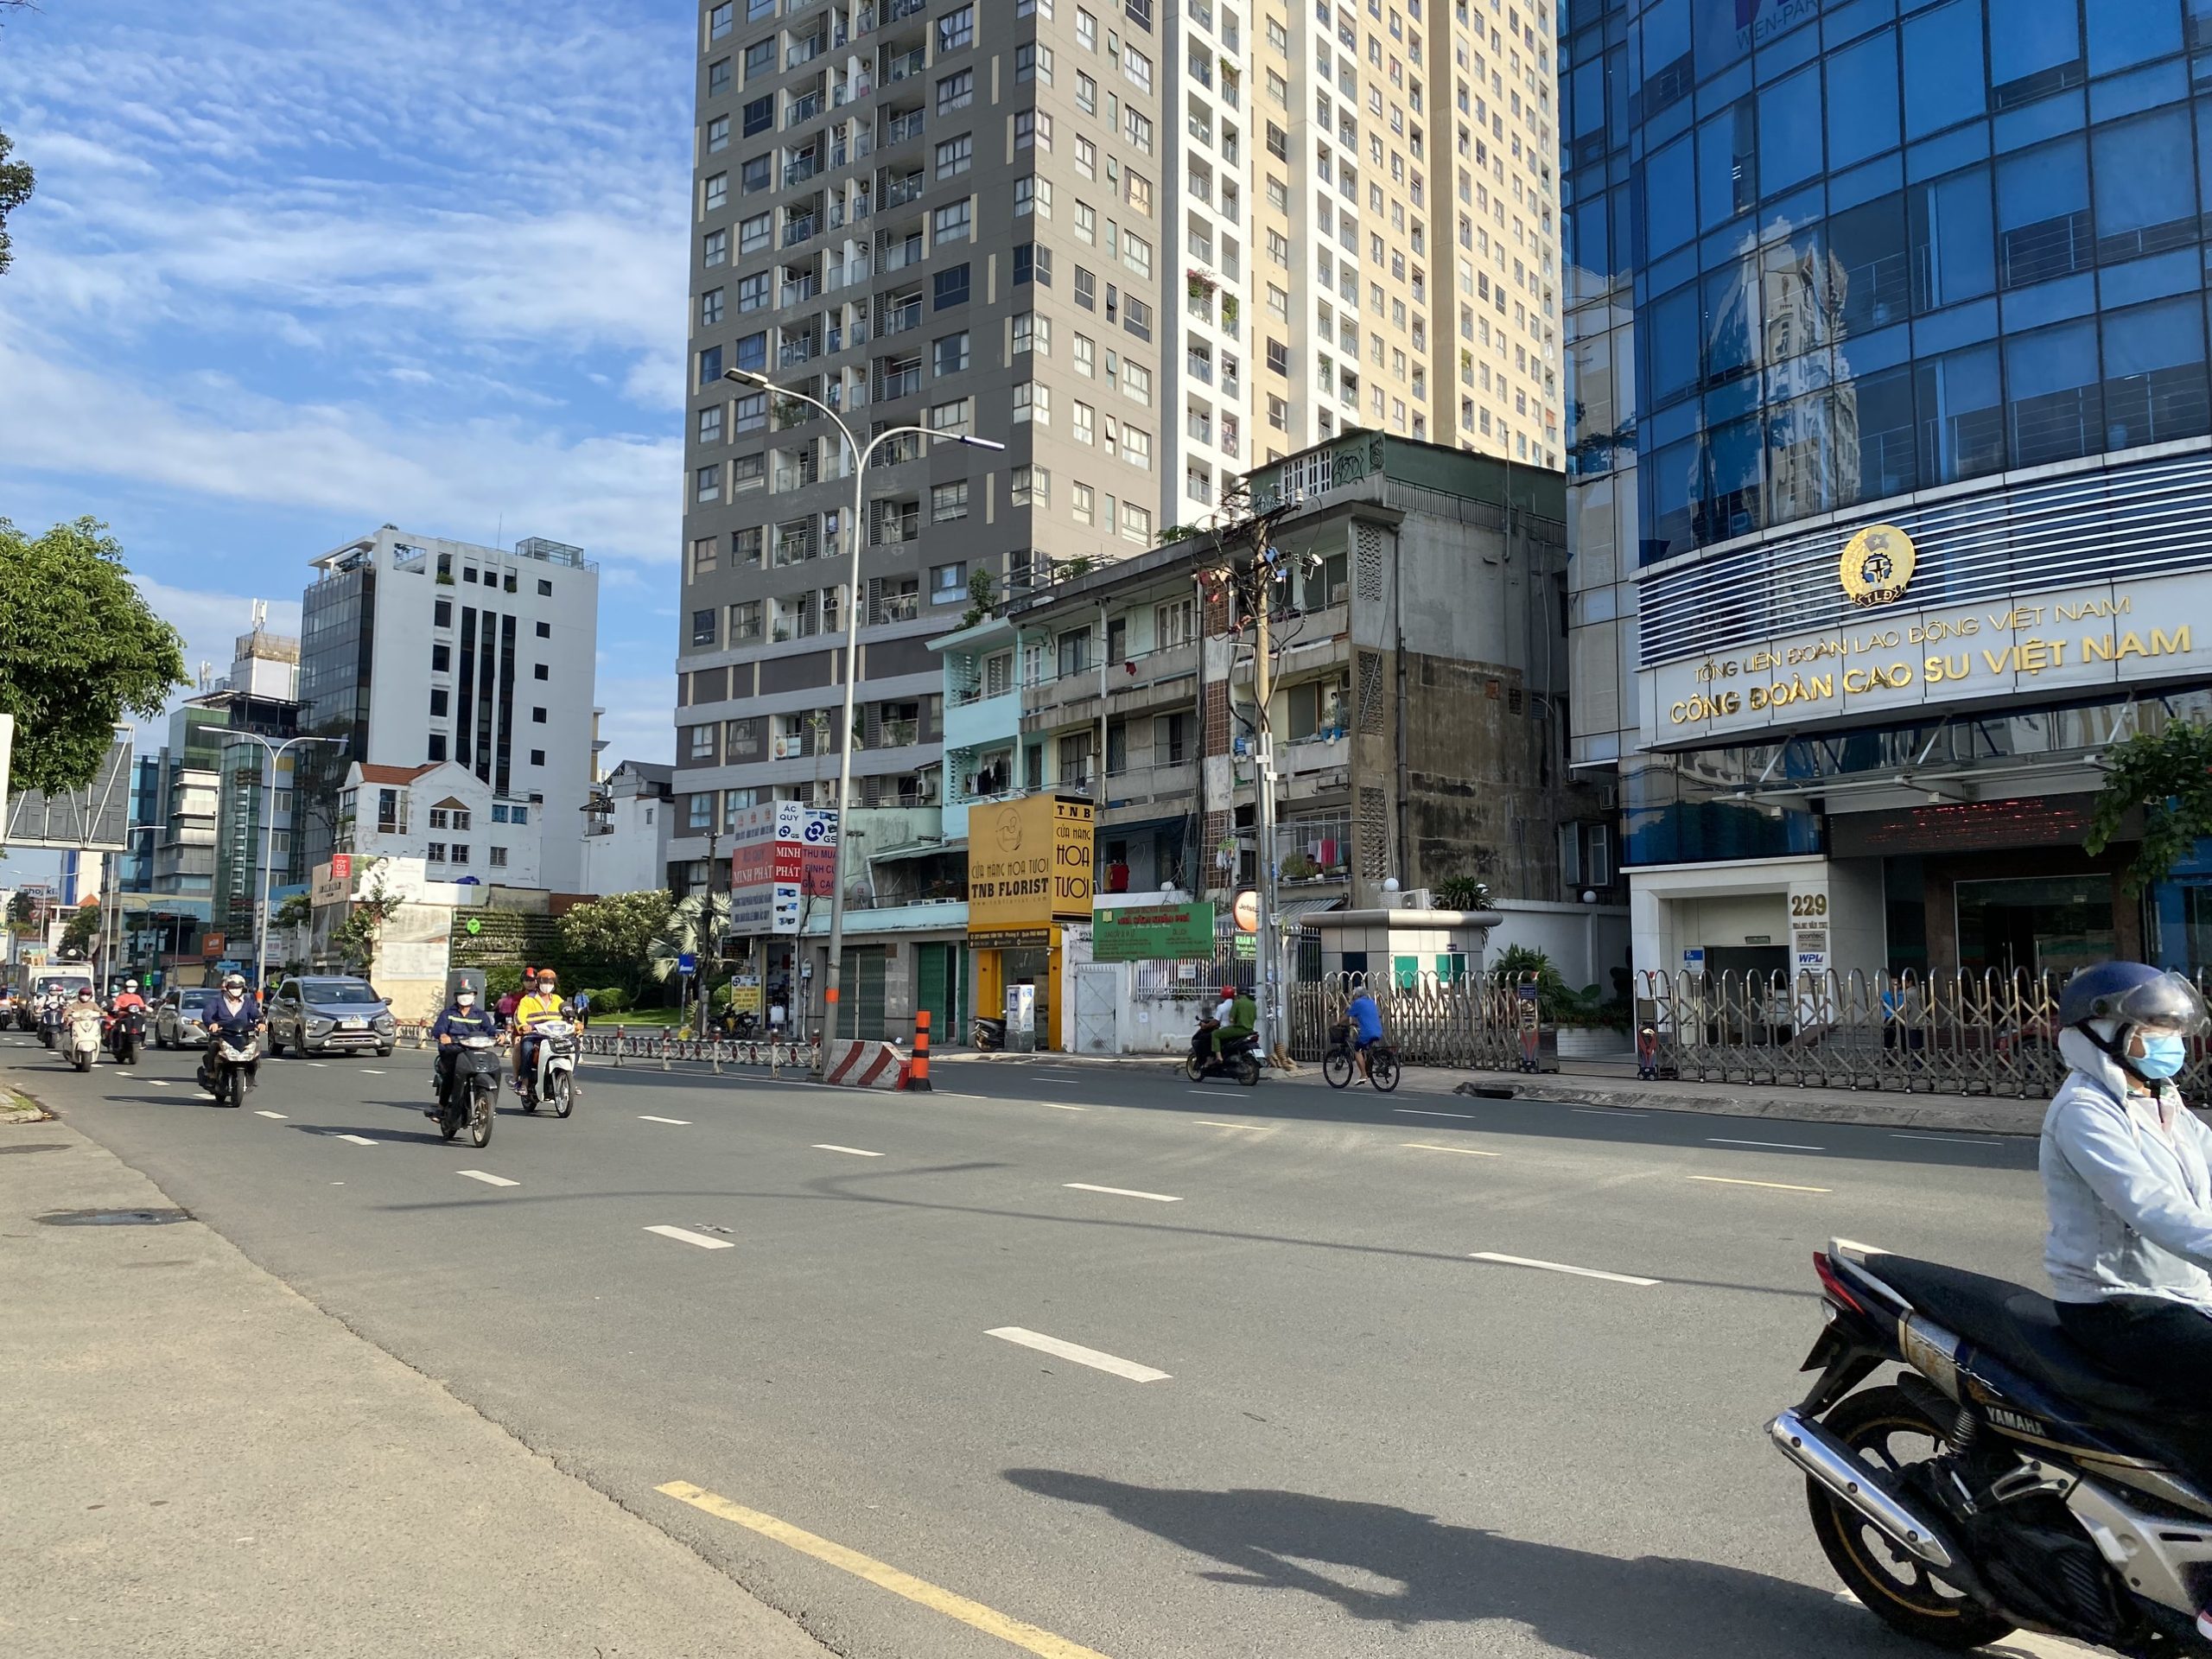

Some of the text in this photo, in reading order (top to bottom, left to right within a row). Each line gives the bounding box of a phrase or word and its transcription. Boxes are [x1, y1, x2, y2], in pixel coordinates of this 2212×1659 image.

[1694, 658, 1738, 683] TỔNG
[1743, 651, 1782, 674] LIÊN
[1854, 630, 1900, 652] LAO
[1909, 617, 1979, 645] ĐỘNG
[1988, 607, 2045, 631] VIỆT
[2056, 595, 2131, 622] NAM
[1670, 625, 2191, 724] CÔNG ĐOÀN CAO SU VIỆT NAM
[1057, 805, 1090, 818] TNB
[776, 847, 801, 858] MINH
[804, 849, 819, 858] THU
[1056, 844, 1090, 868] HOA
[776, 864, 800, 877] PHÁT
[1007, 861, 1026, 876] HOA
[971, 878, 1049, 899] TNB FLORIST
[1054, 875, 1090, 899] TƯƠI
[1791, 893, 1827, 916] 229
[1986, 1406, 2046, 1437] YAMAHA
